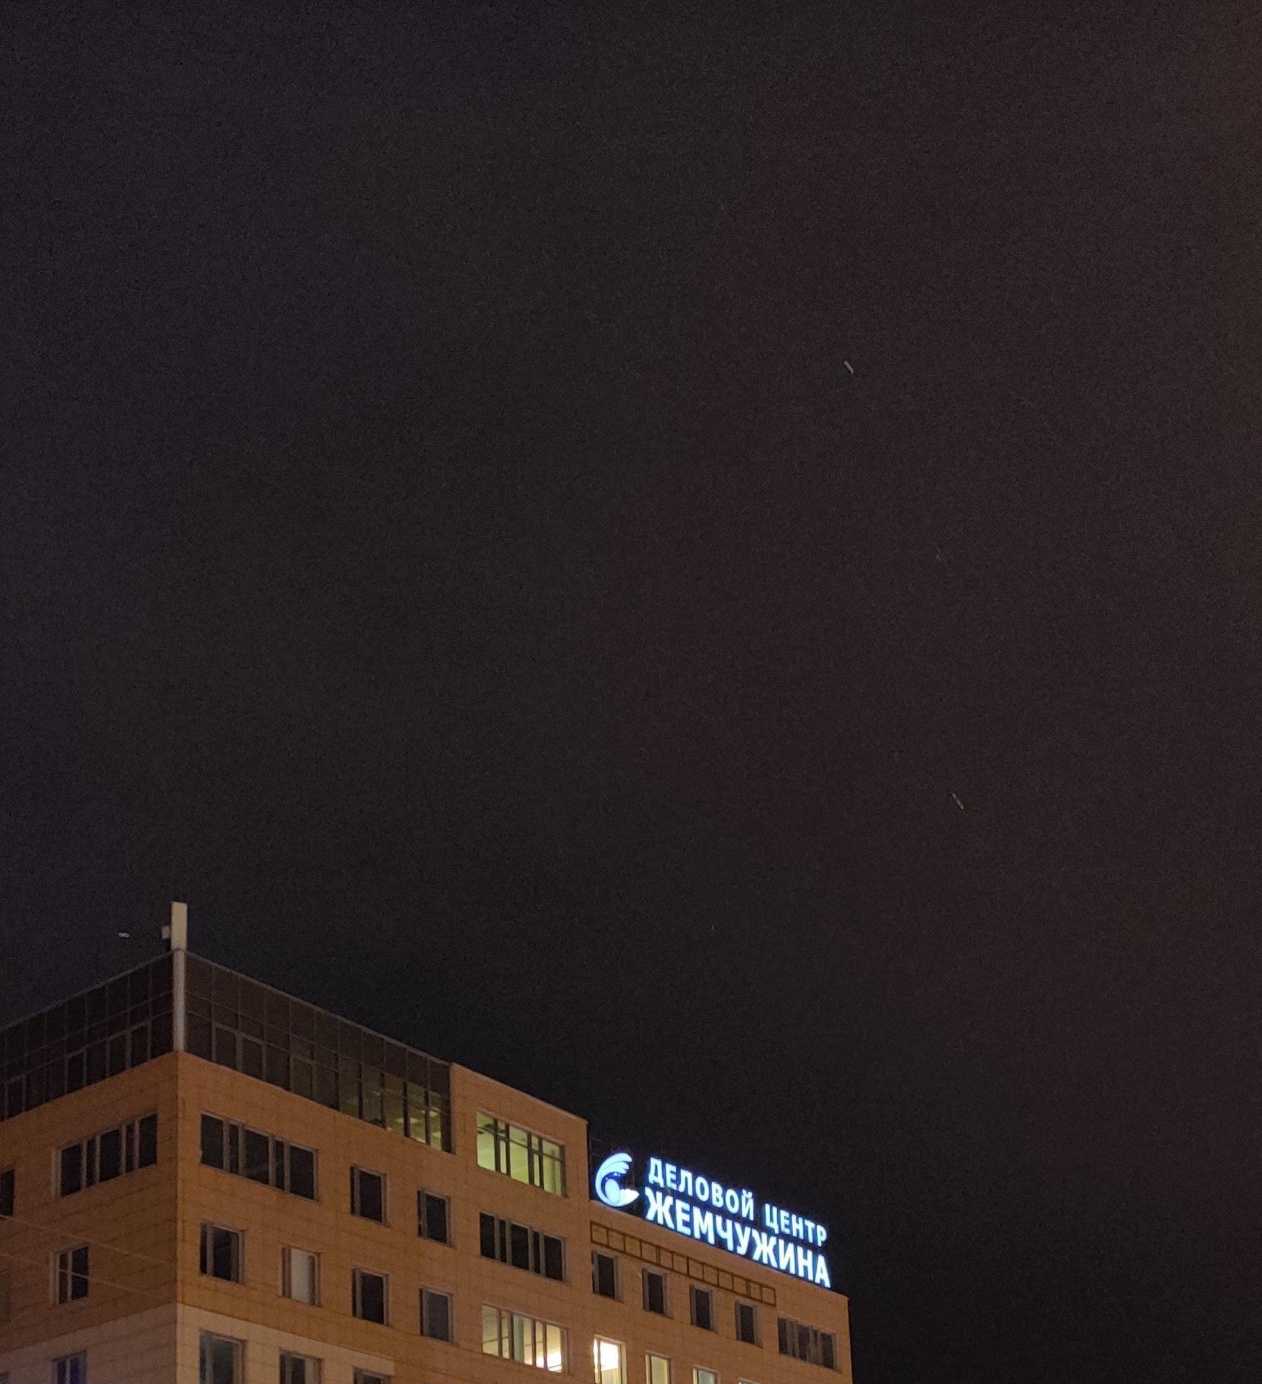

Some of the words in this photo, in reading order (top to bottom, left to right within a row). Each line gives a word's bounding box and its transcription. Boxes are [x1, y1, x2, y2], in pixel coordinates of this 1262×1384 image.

[645, 1187, 831, 1288] ЖЕМЧУЖИНА
[648, 1157, 754, 1220] ДЕЛОВОЙ
[765, 1203, 828, 1247] ЦЕНТР
